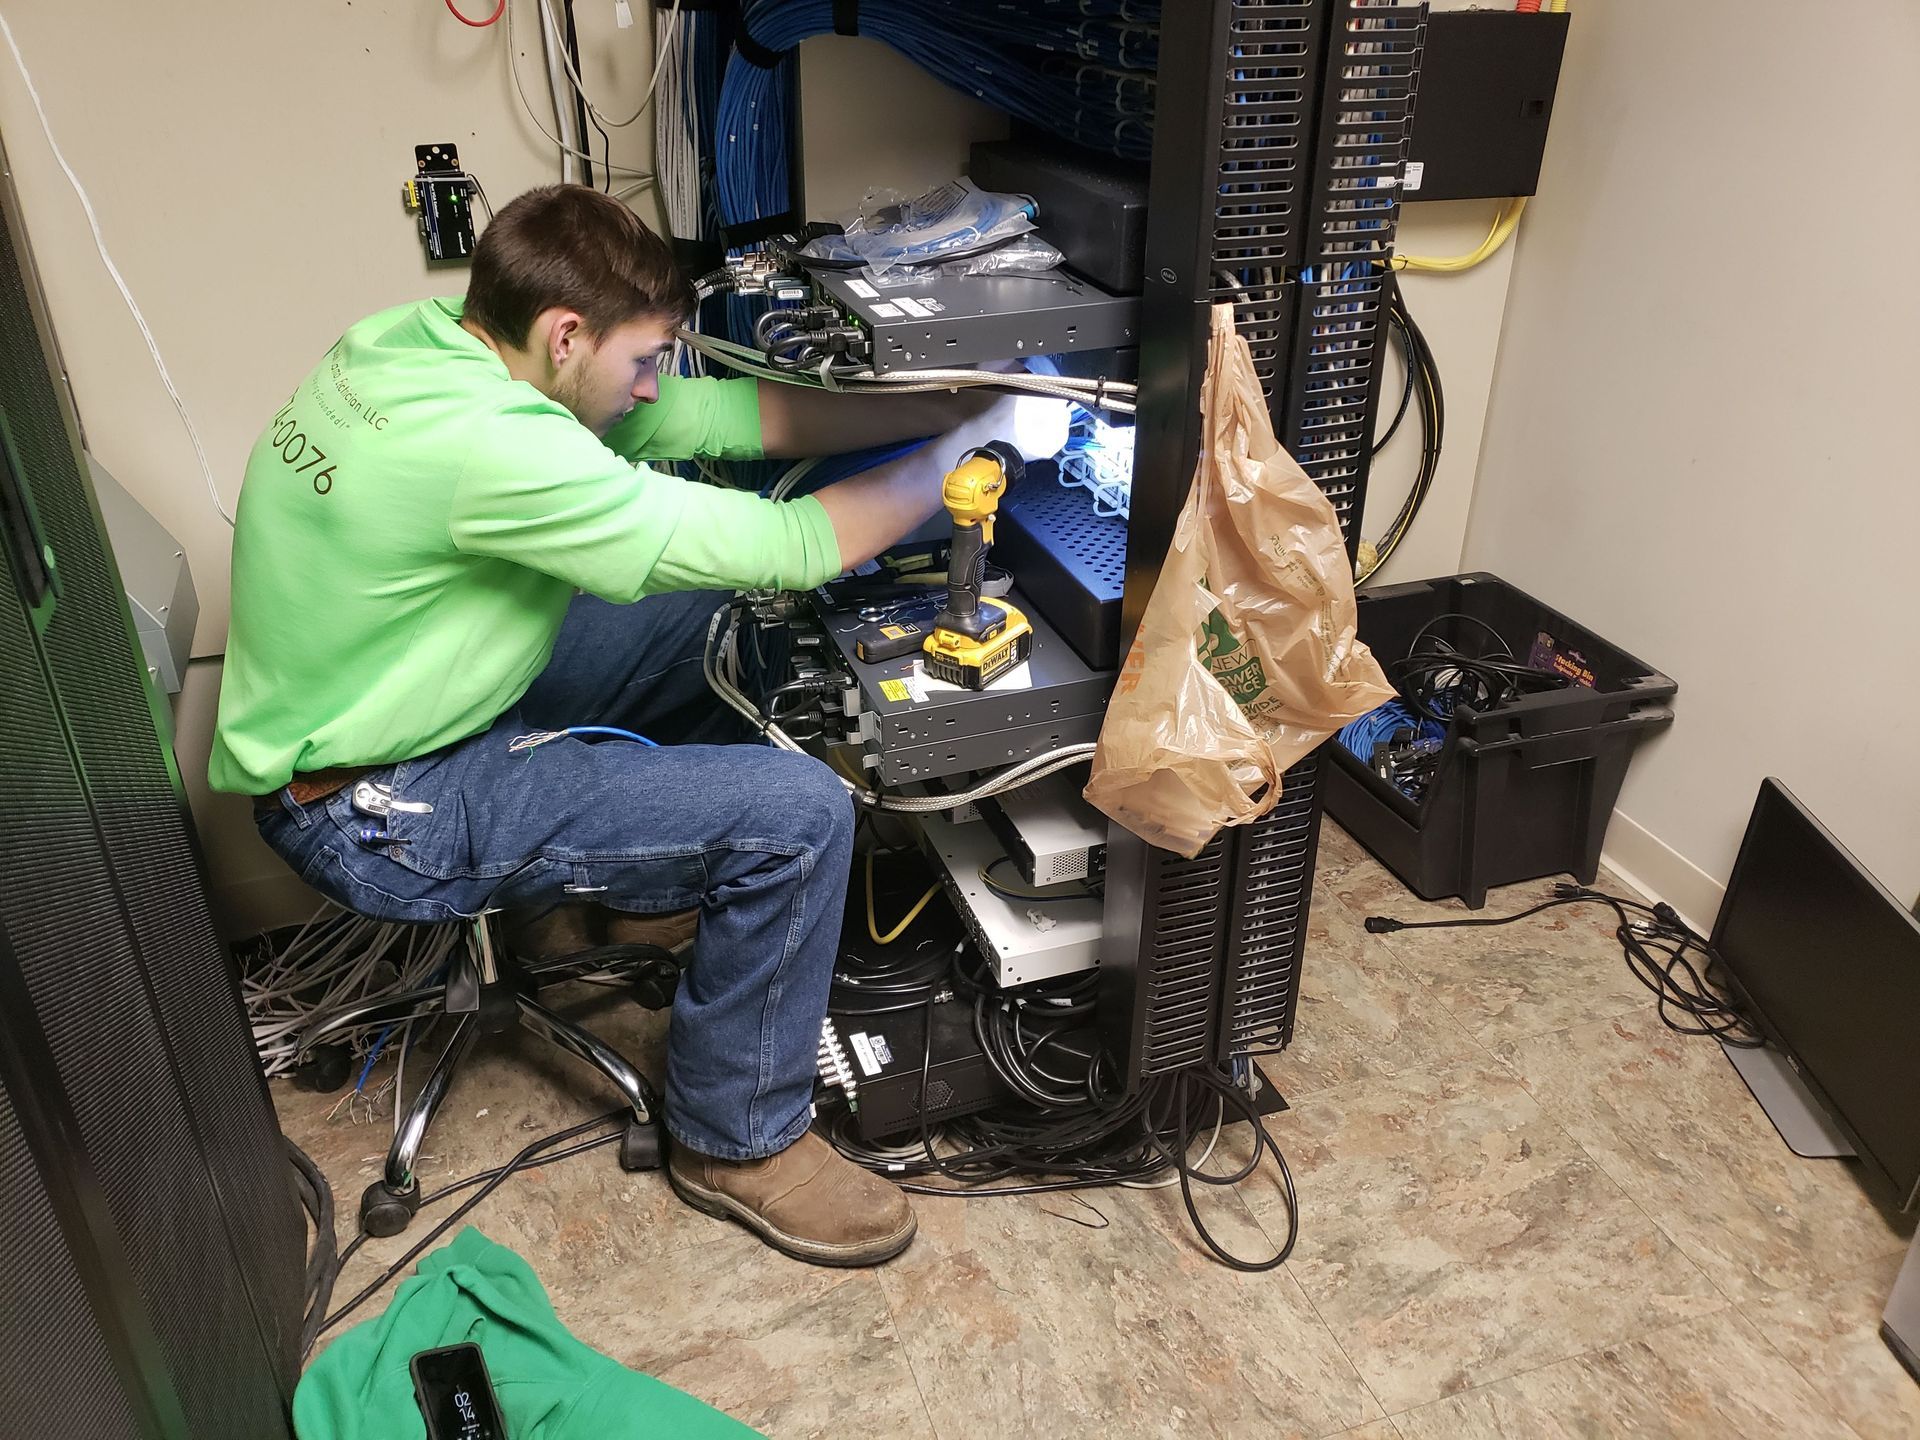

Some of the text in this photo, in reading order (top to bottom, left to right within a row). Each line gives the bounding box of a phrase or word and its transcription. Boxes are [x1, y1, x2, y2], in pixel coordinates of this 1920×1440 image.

[363, 407, 389, 431] LLC
[1213, 647, 1248, 671] NEW
[1217, 662, 1262, 687] OWER
[1228, 676, 1261, 697] RICE
[455, 1391, 472, 1408] 02
[459, 1406, 476, 1422] 14
